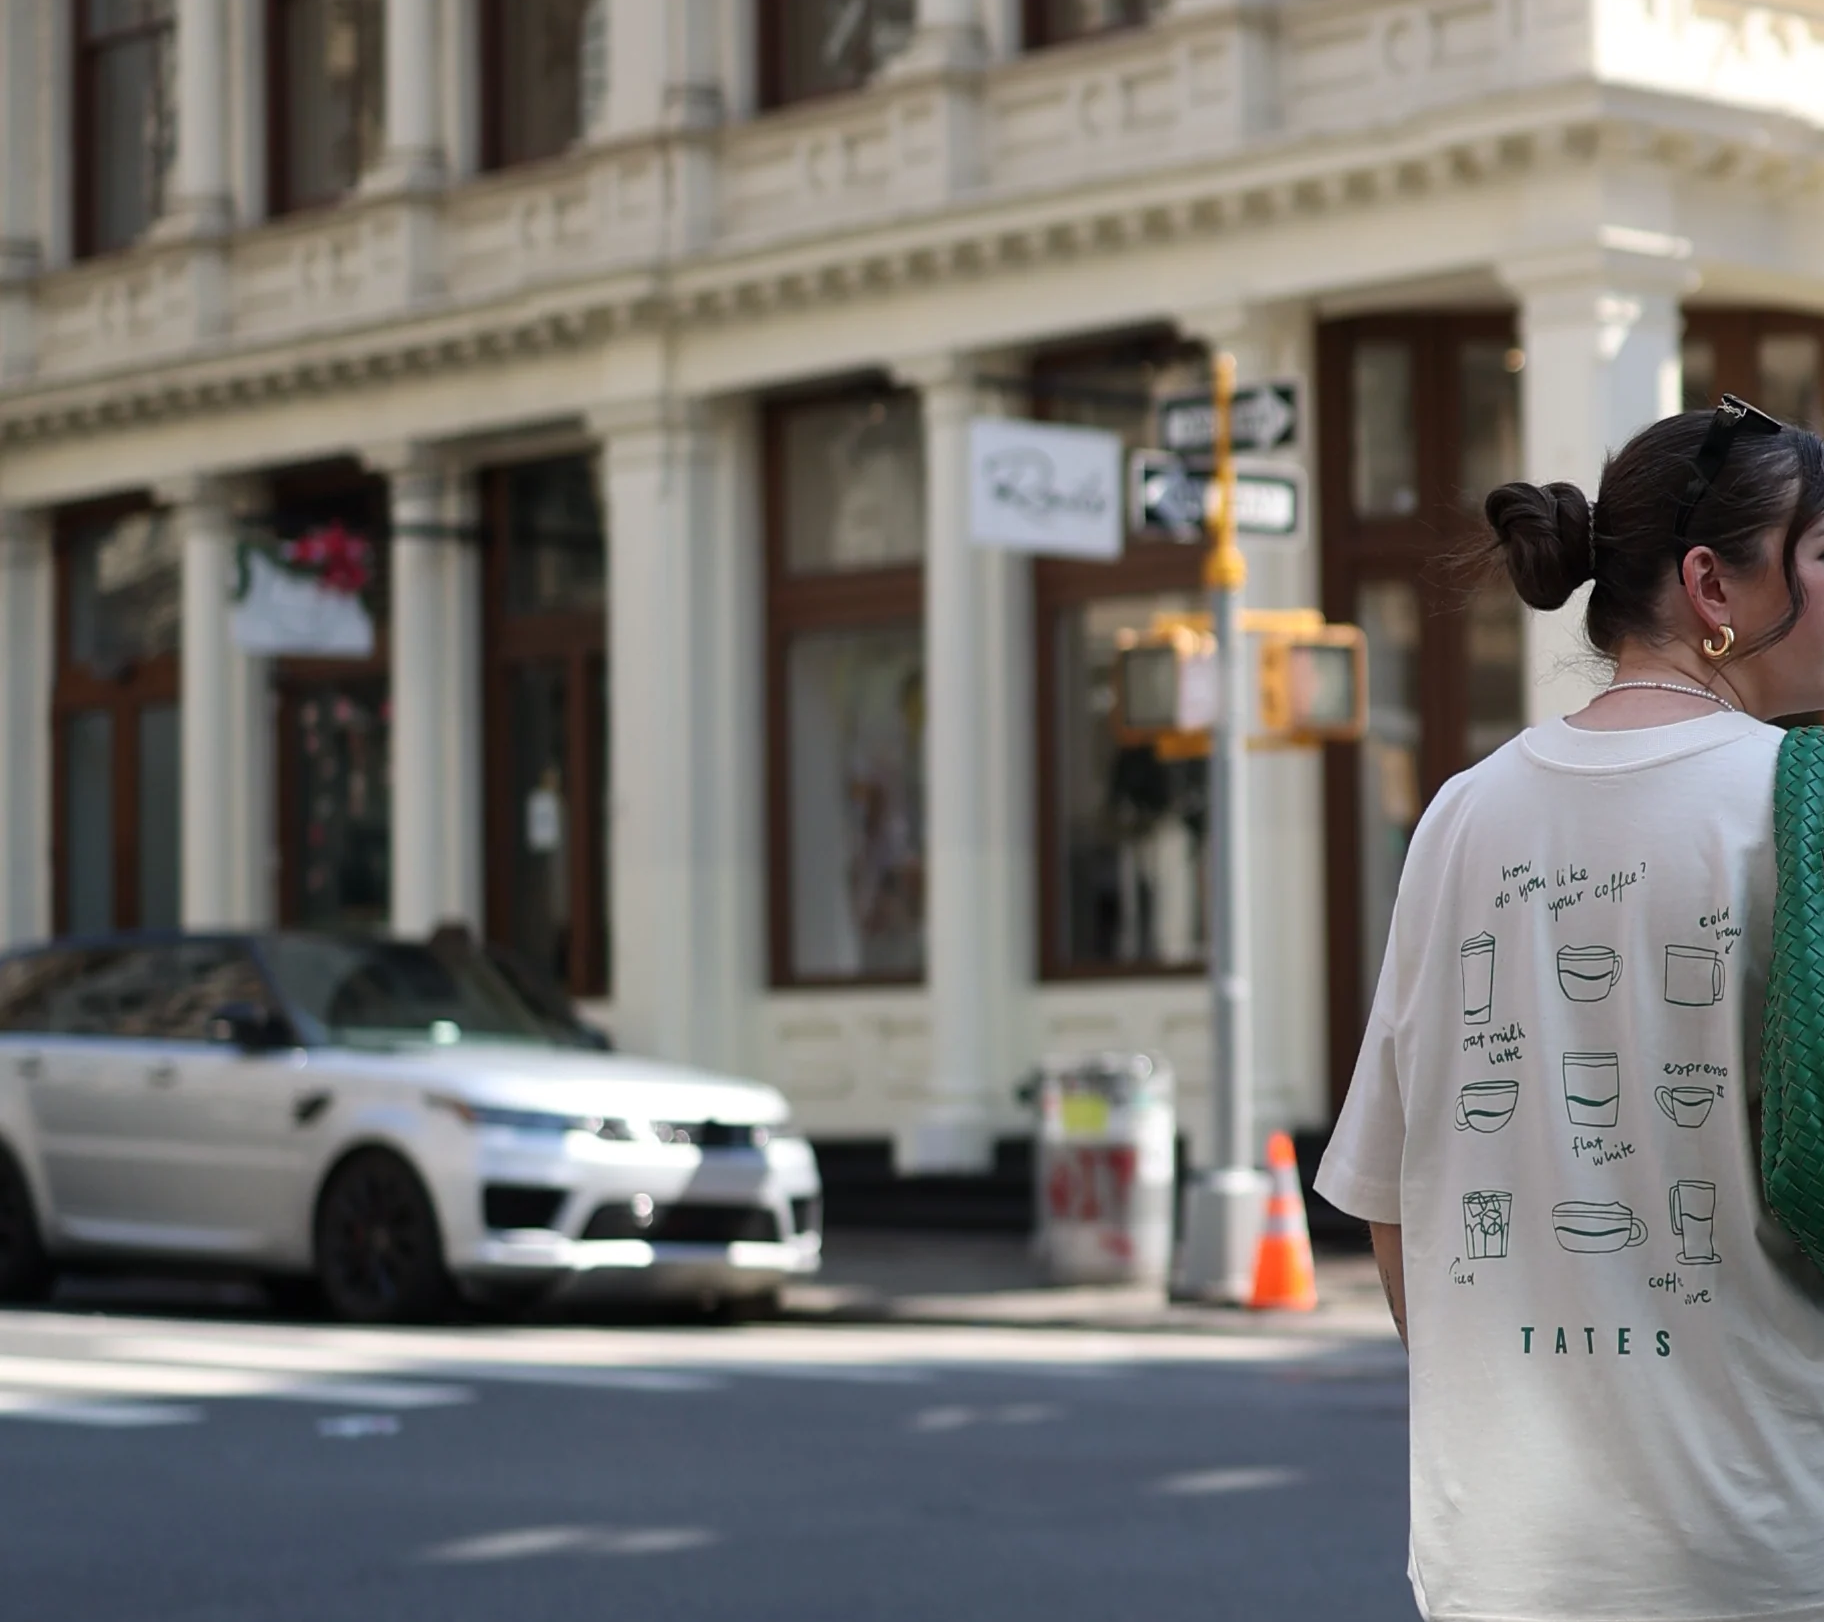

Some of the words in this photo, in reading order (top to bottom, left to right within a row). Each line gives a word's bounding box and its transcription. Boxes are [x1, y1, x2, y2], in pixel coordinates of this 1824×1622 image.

[1502, 860, 1531, 881] how
[1495, 891, 1511, 909] do
[1519, 876, 1546, 903] you
[1556, 864, 1589, 887] like
[1548, 890, 1584, 922] your
[1595, 862, 1646, 903] coffee?
[1699, 906, 1729, 928] cold
[1715, 927, 1742, 941] brew
[1463, 1032, 1485, 1051] oat
[1489, 1022, 1526, 1044] milk
[1489, 1046, 1523, 1065] latte
[1663, 1063, 1728, 1077] espresso
[1572, 1136, 1603, 1158] flat
[1592, 1141, 1635, 1166] white
[1521, 1327, 1670, 1357] TATES
